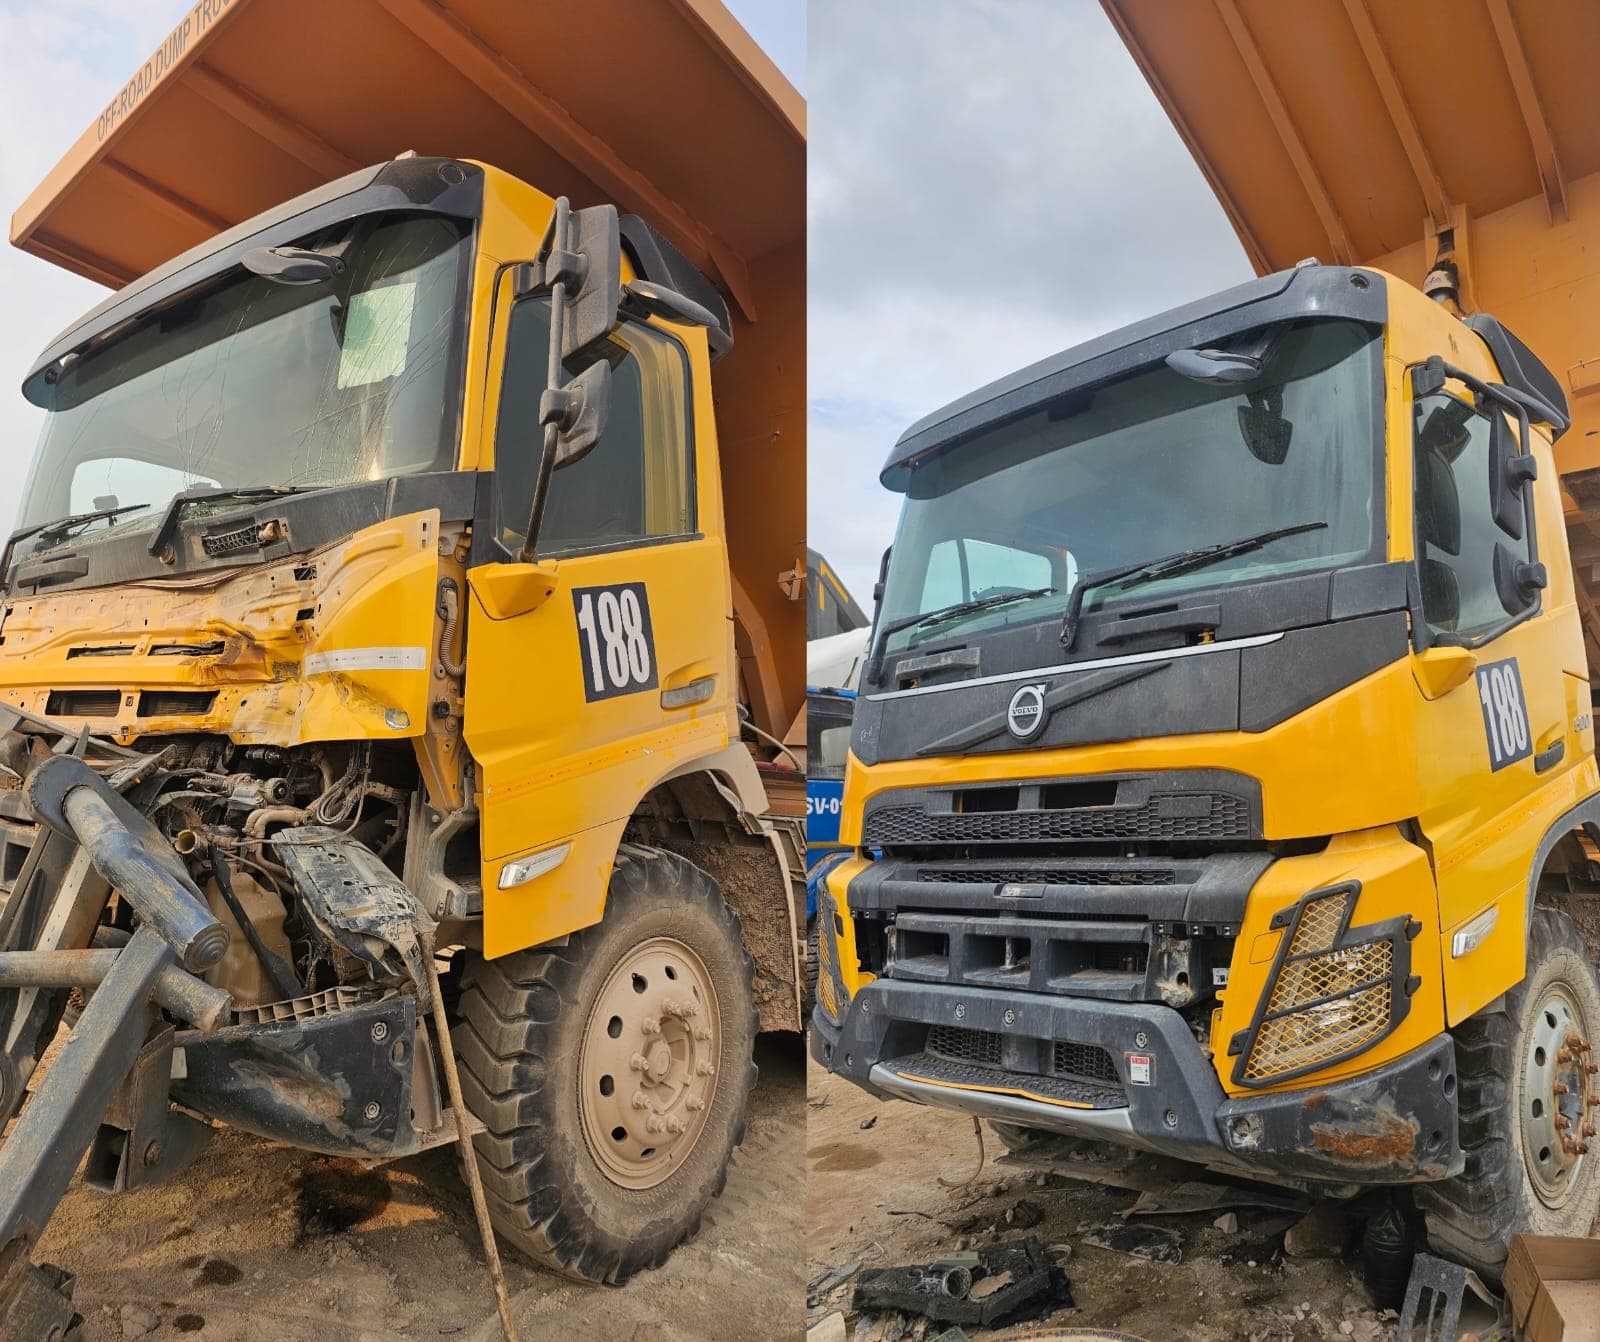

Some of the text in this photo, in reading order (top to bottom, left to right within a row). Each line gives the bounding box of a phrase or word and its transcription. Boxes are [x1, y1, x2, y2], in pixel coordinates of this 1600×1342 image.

[97, 62, 152, 142] OFF-ROAD
[155, 18, 190, 80] DUMP
[578, 588, 650, 692] 188
[1012, 706, 1039, 715] VOLVO
[1480, 664, 1527, 762] 188
[806, 797, 842, 815] SV-0
